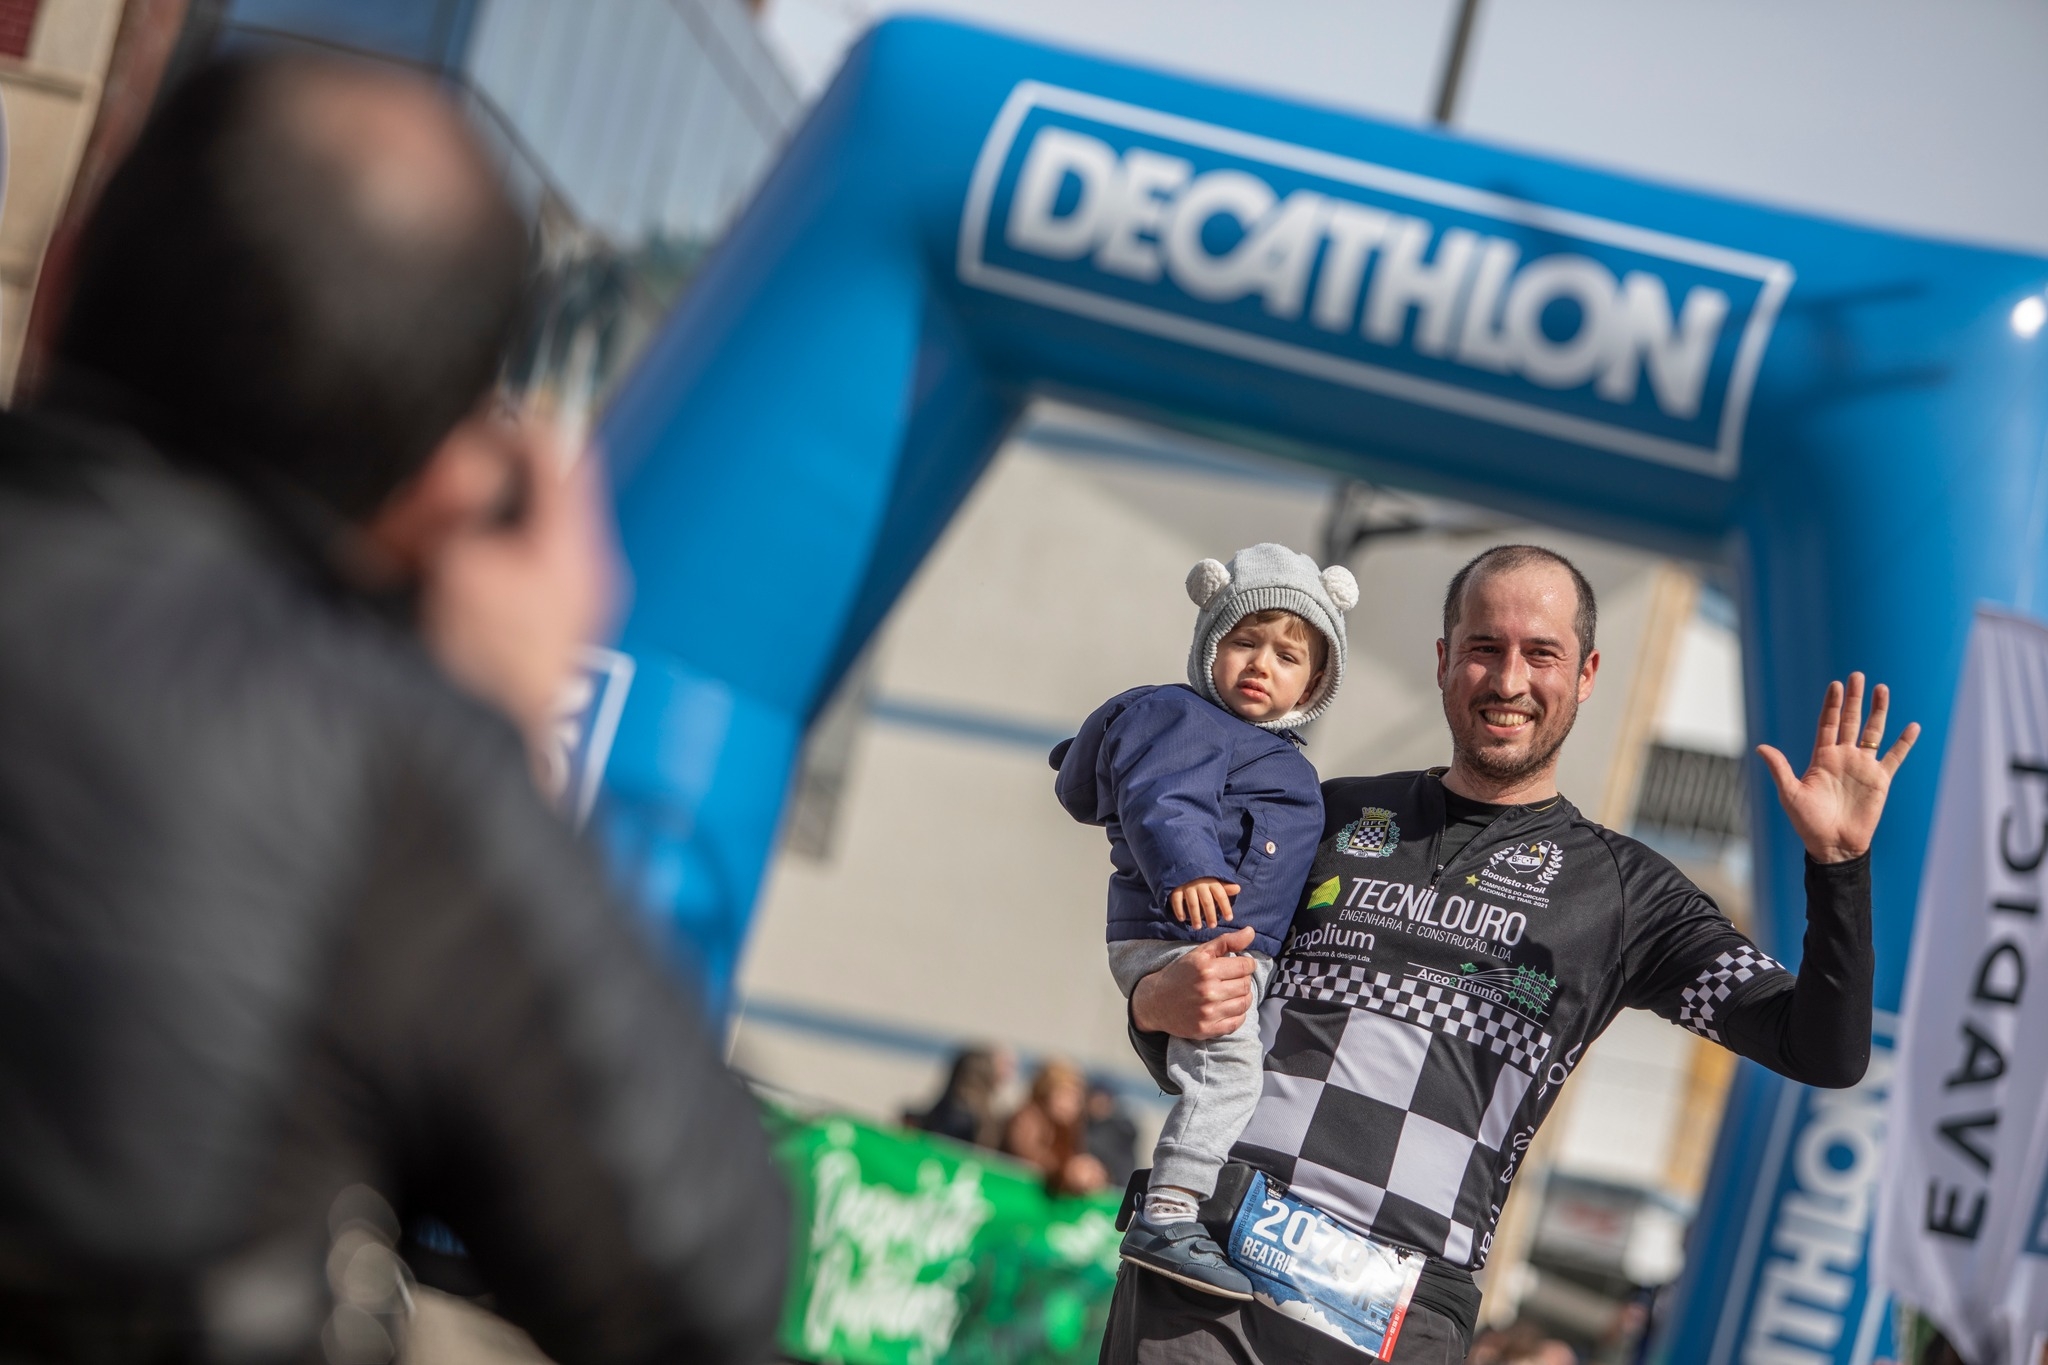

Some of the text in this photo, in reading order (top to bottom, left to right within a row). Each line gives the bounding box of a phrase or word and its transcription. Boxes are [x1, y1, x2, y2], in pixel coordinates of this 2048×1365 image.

[1004, 124, 1730, 421] DECATHLON
[1345, 877, 1527, 946] TECNILOURO
[1477, 885, 1507, 898] NACIONAL
[1516, 896, 1533, 905] TRAIL
[1533, 901, 1549, 909] 2021
[1522, 893, 1550, 904] CIRCUITO
[1336, 952, 1357, 961] design
[1357, 954, 1372, 963] Lda.
[1339, 909, 1403, 932] ENGENHARIA
[1406, 923, 1415, 934] E
[1492, 947, 1513, 963] LDA.
[1416, 968, 1450, 986] Arco
[1457, 976, 1503, 1002] Triunfo
[1252, 1198, 1370, 1284] 2079
